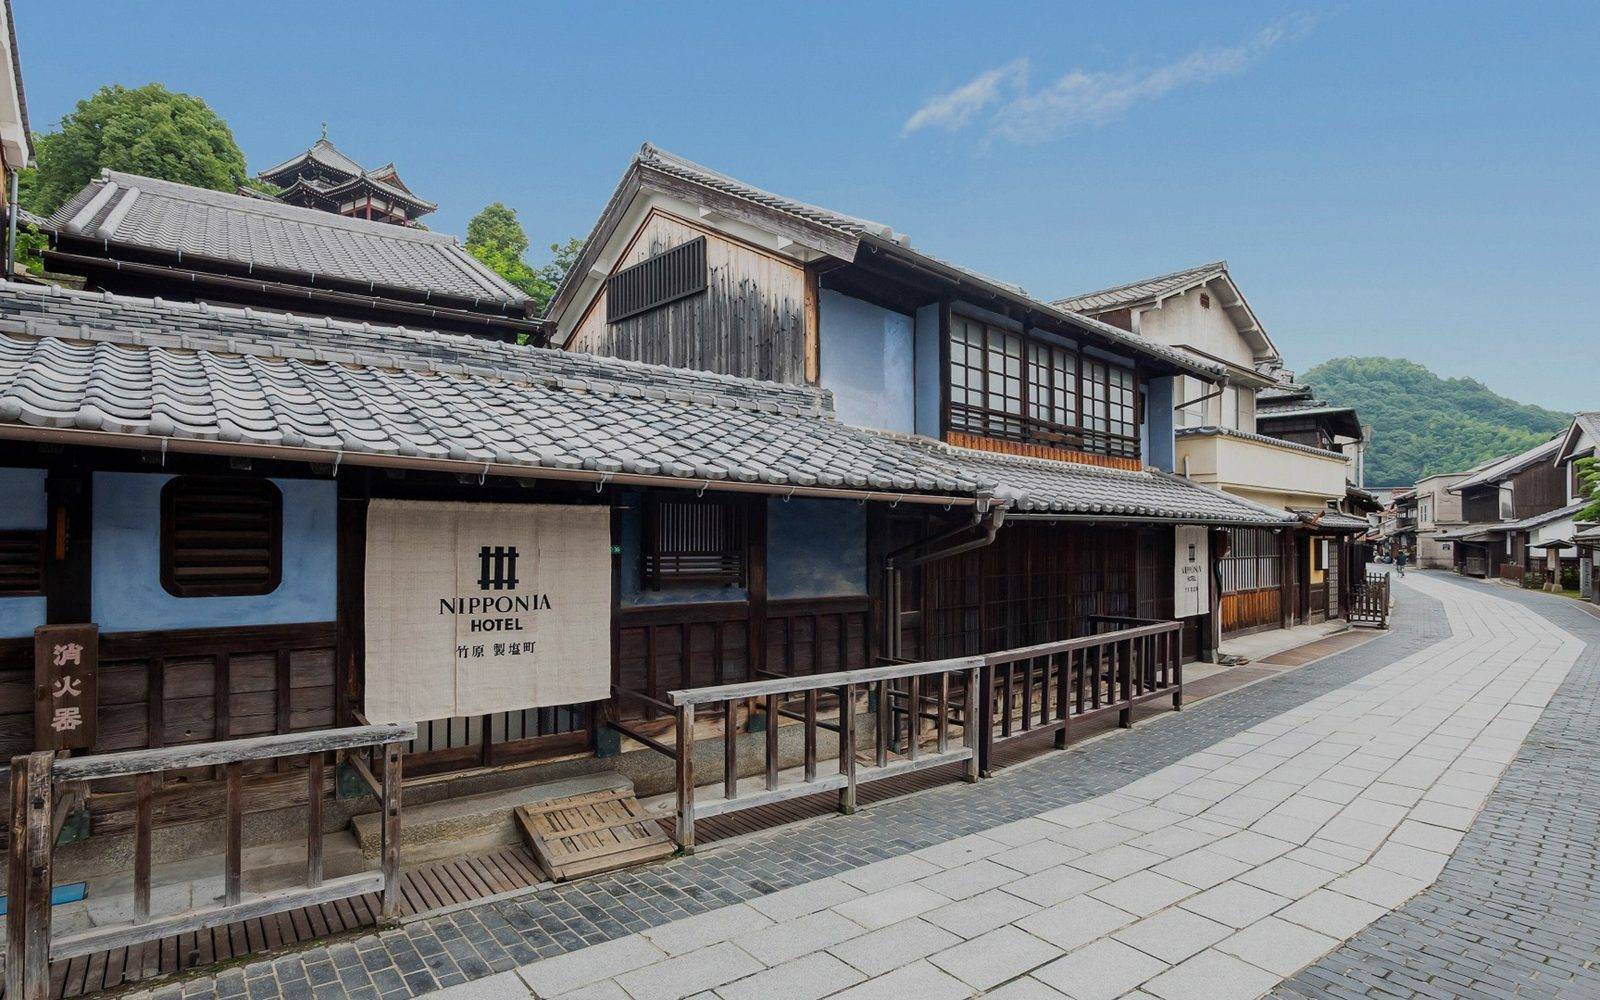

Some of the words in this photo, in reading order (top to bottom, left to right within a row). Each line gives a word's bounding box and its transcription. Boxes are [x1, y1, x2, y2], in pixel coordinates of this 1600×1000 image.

[439, 593, 551, 615] NIPPONIA
[471, 618, 523, 632] HOTEL
[456, 645, 485, 658] 竹原
[493, 641, 536, 657] 製塩町
[51, 642, 83, 732] 消火器
